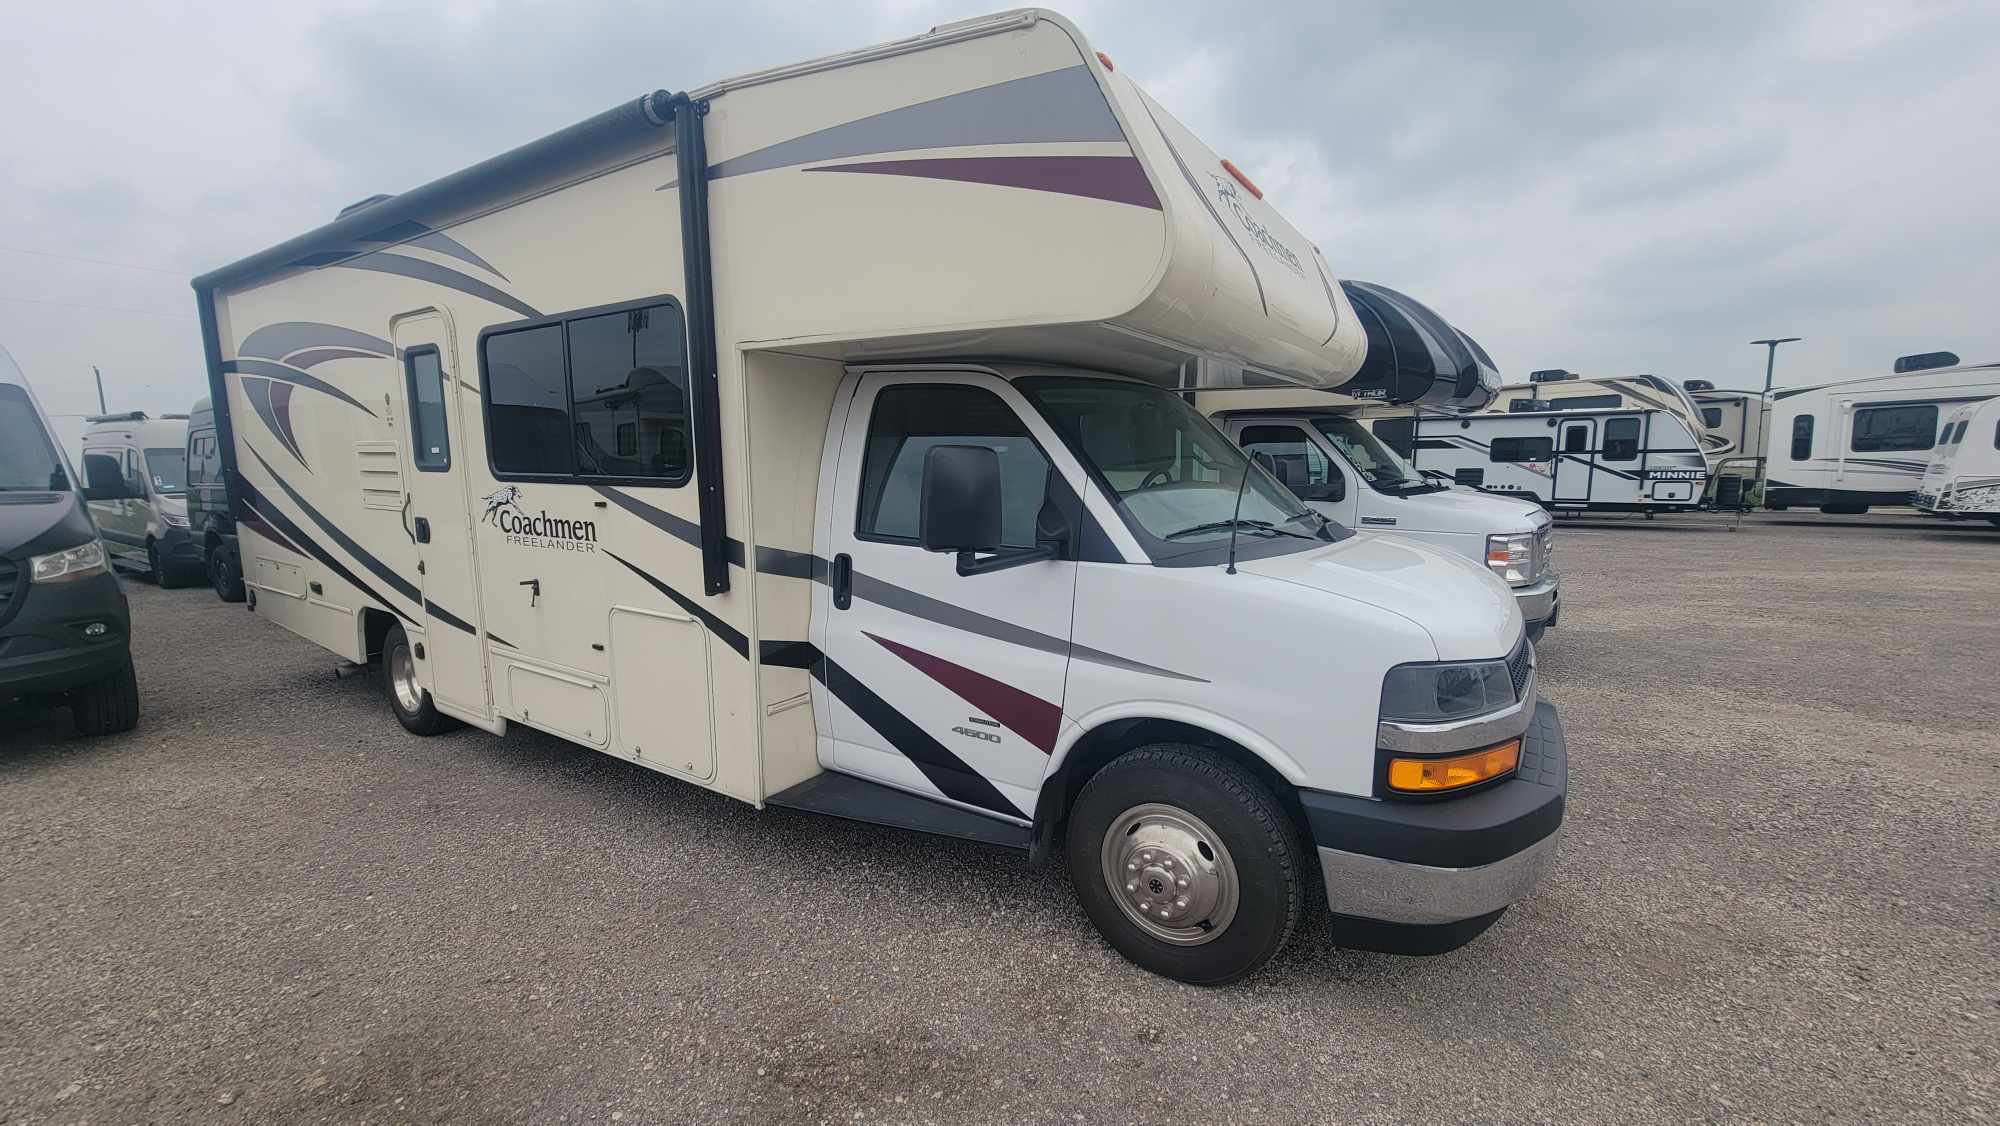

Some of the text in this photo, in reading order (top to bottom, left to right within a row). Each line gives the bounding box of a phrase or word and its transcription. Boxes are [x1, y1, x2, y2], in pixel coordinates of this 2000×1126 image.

[1648, 471, 1706, 479] MINNIE
[499, 509, 598, 542] Coachmen
[505, 535, 596, 554] FREELANDER
